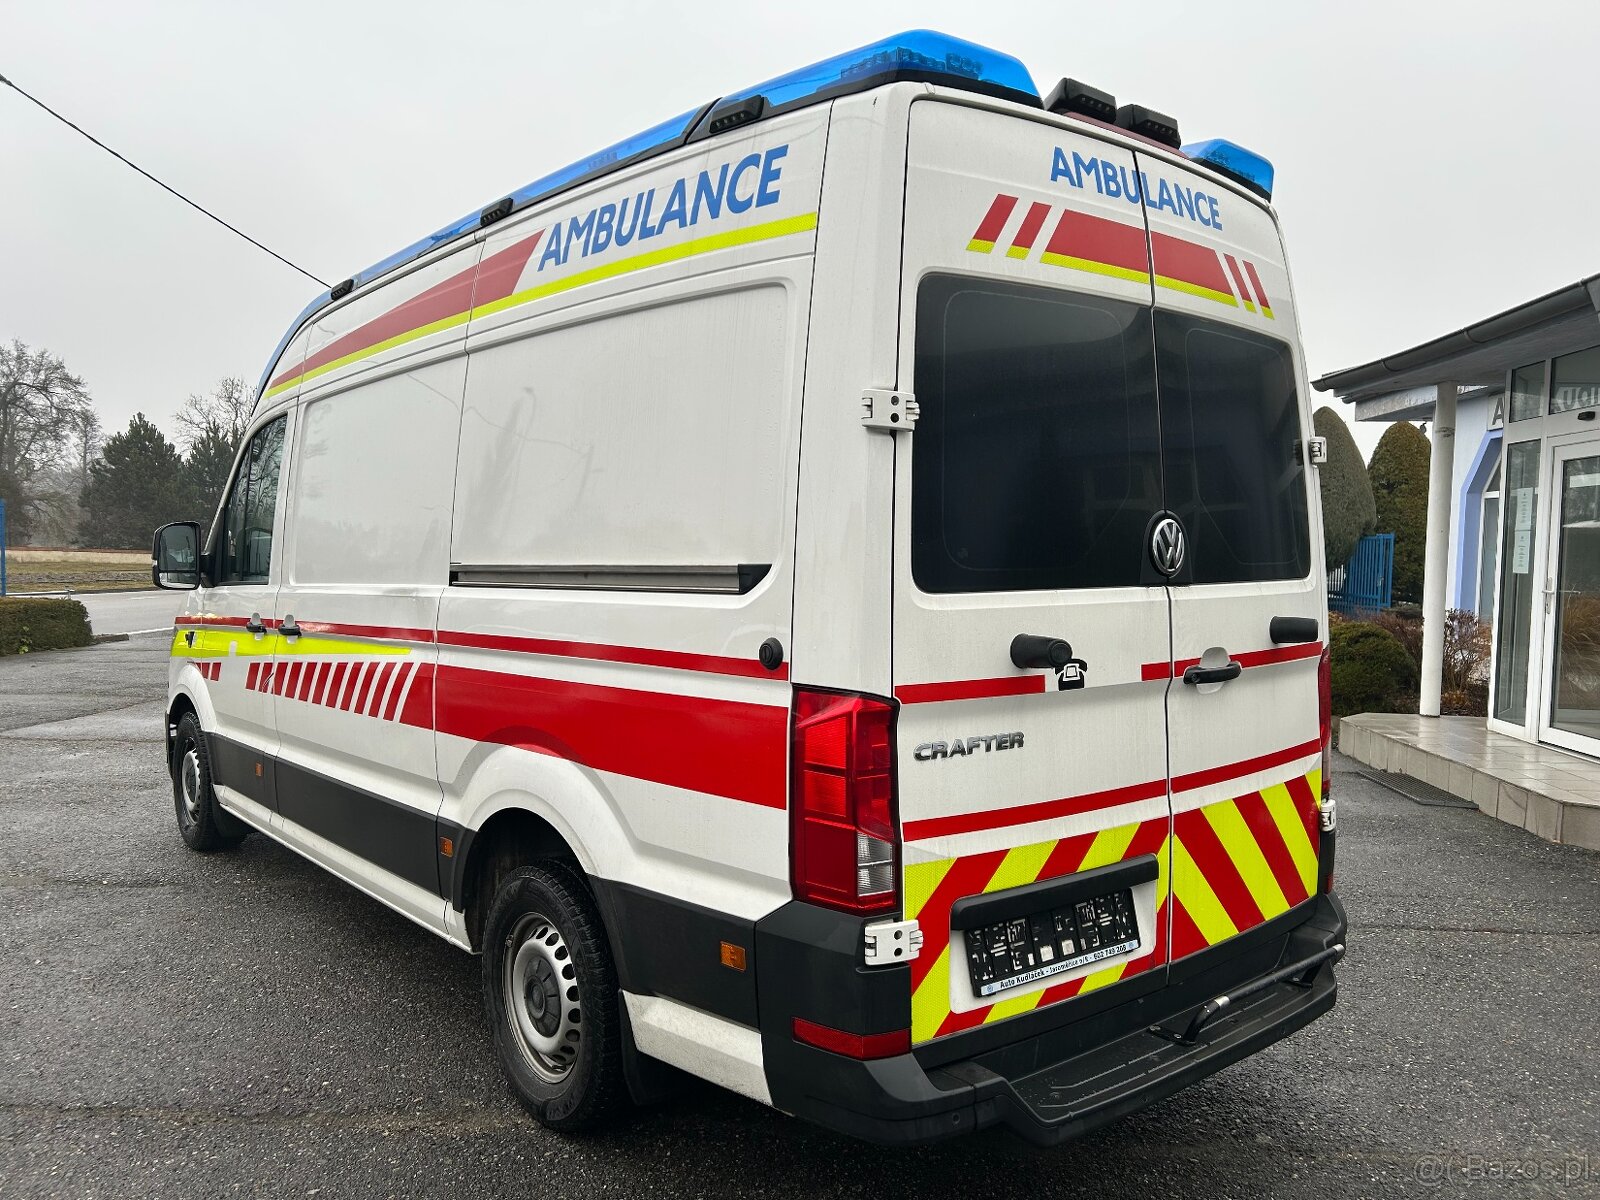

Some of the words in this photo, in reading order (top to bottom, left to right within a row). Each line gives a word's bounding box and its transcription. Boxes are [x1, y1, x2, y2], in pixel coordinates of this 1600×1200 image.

[537, 144, 789, 272] AMBULANCE
[1050, 146, 1223, 231] AMBULANCE
[913, 731, 1025, 761] CRAFTER
[1000, 979, 1015, 989] Auto
